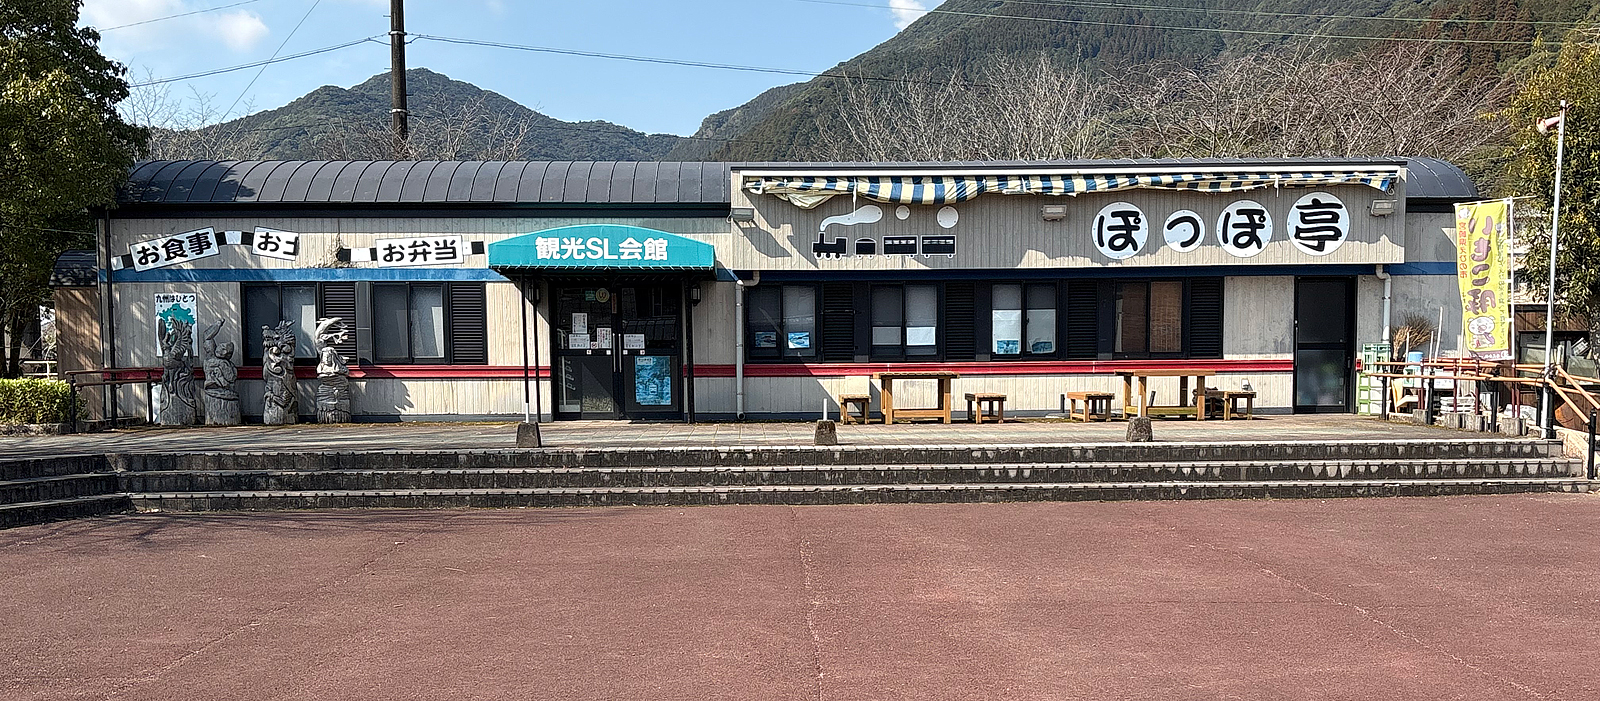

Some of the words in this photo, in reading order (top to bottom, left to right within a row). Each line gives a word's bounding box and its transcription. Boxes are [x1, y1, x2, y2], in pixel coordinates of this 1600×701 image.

[136, 232, 213, 264] お食事
[382, 239, 457, 262] お弁当
[535, 236, 669, 261] 観光SL会館
[155, 294, 196, 304] 九州はひとつ
